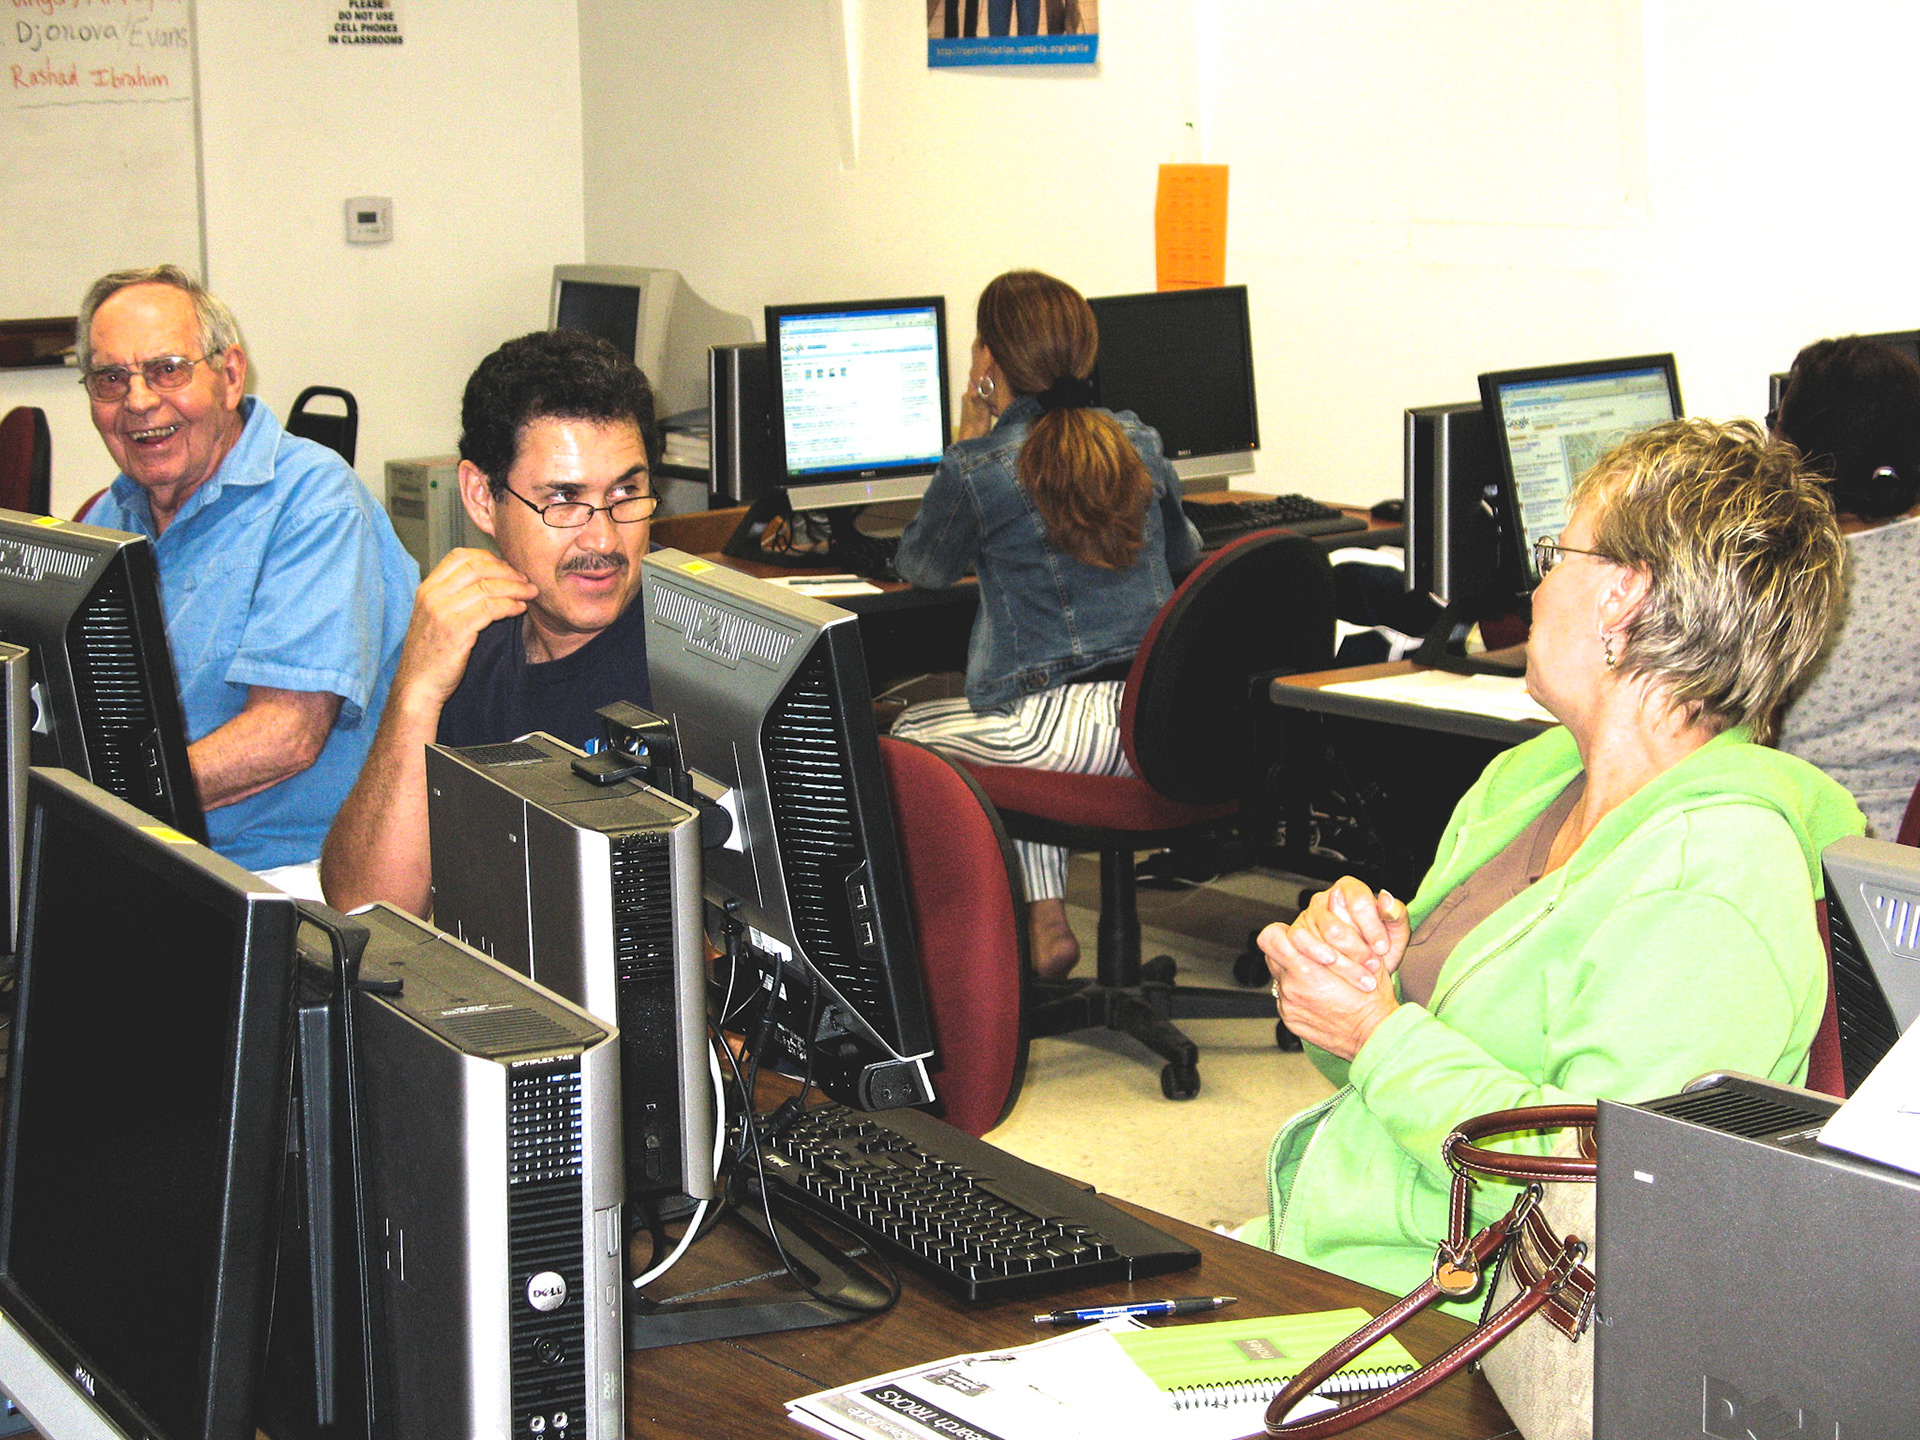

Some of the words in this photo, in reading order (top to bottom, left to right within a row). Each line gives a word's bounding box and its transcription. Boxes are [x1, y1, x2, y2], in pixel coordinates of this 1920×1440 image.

[349, 0, 384, 8] PLEASE
[338, 11, 352, 20] DO
[354, 11, 373, 20] NOT
[376, 11, 394, 20] USE
[334, 23, 358, 32] CELL
[361, 23, 397, 32] PHONES
[328, 35, 338, 43] IN
[341, 35, 403, 44] CLASSROOMS
[89, 63, 170, 89] Ibrahim
[511, 1056, 555, 1068] OPTIPLEX
[533, 1286, 564, 1298] DELL
[1245, 1340, 1276, 1360] notes
[875, 1389, 939, 1422] TRICKS
